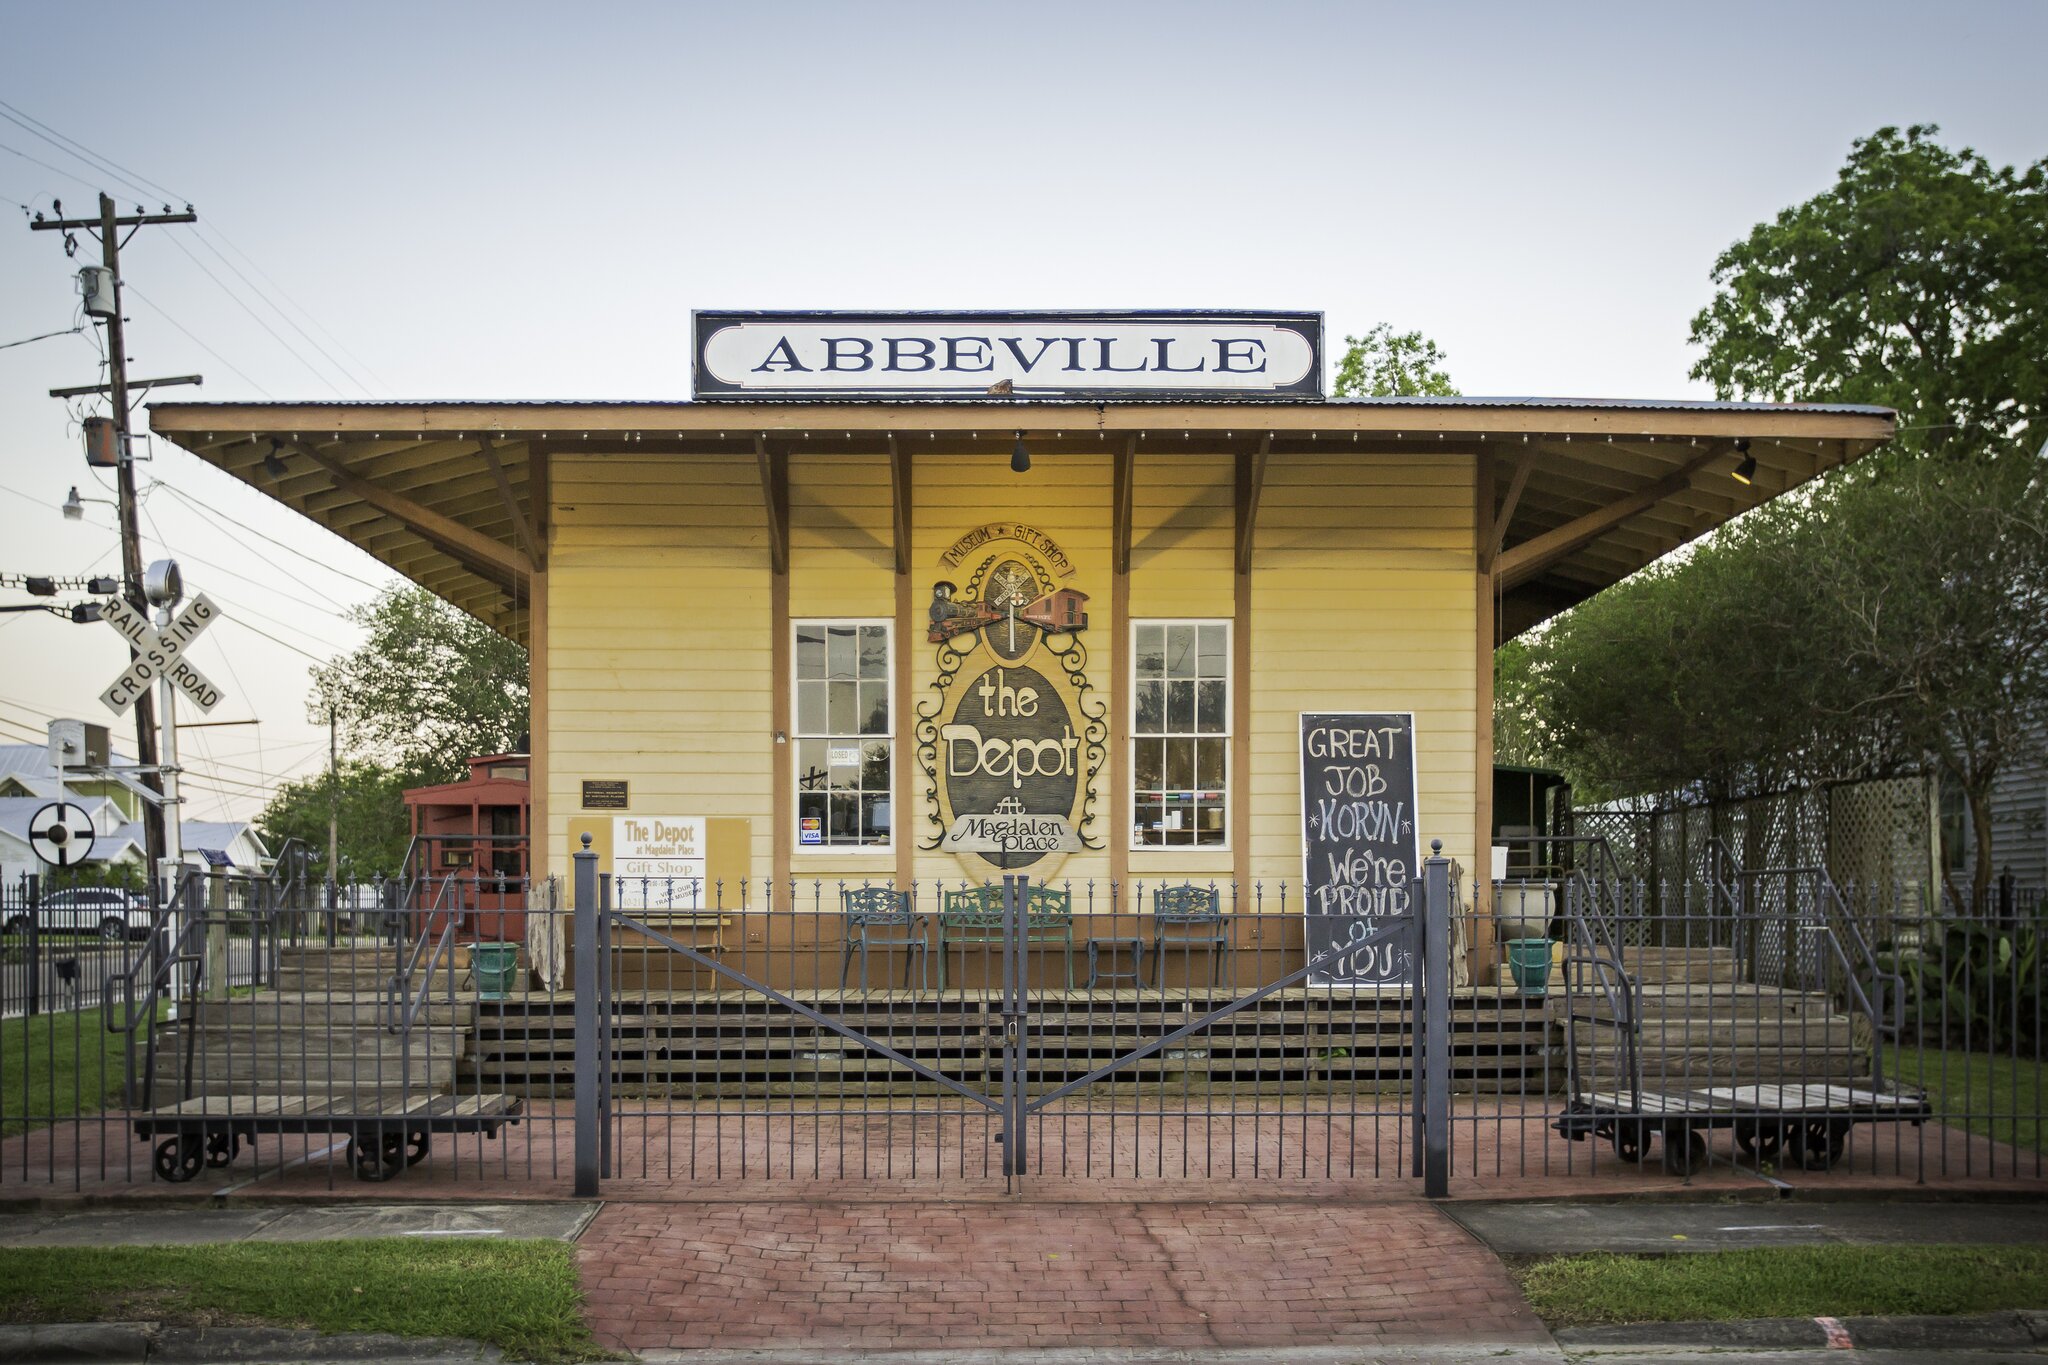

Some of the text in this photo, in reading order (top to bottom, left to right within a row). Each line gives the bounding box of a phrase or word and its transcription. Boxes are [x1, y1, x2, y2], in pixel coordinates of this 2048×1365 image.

[751, 335, 1267, 373] ABBEVILLE
[948, 525, 1068, 570] MUSEUM GIFT SHOP
[103, 598, 146, 645] RAIL
[110, 602, 210, 706] CROSSING
[171, 663, 217, 708] ROAD
[978, 669, 1039, 717] the
[941, 724, 1081, 788] Depot
[1307, 727, 1403, 759] GREAT
[1323, 763, 1387, 798] JOB
[993, 797, 1026, 815] At
[1318, 799, 1404, 844] KORYN
[625, 820, 694, 846] The Depot
[951, 818, 1064, 843] Magdalen
[645, 844, 675, 856] Magdalen
[678, 844, 695, 855] Place
[1328, 847, 1406, 886] We're
[626, 861, 693, 876] Gift Shop
[675, 888, 703, 899] MUSEM
[677, 884, 691, 892] OUR
[1314, 884, 1410, 916] PROUD
[1331, 940, 1393, 977] YOU
